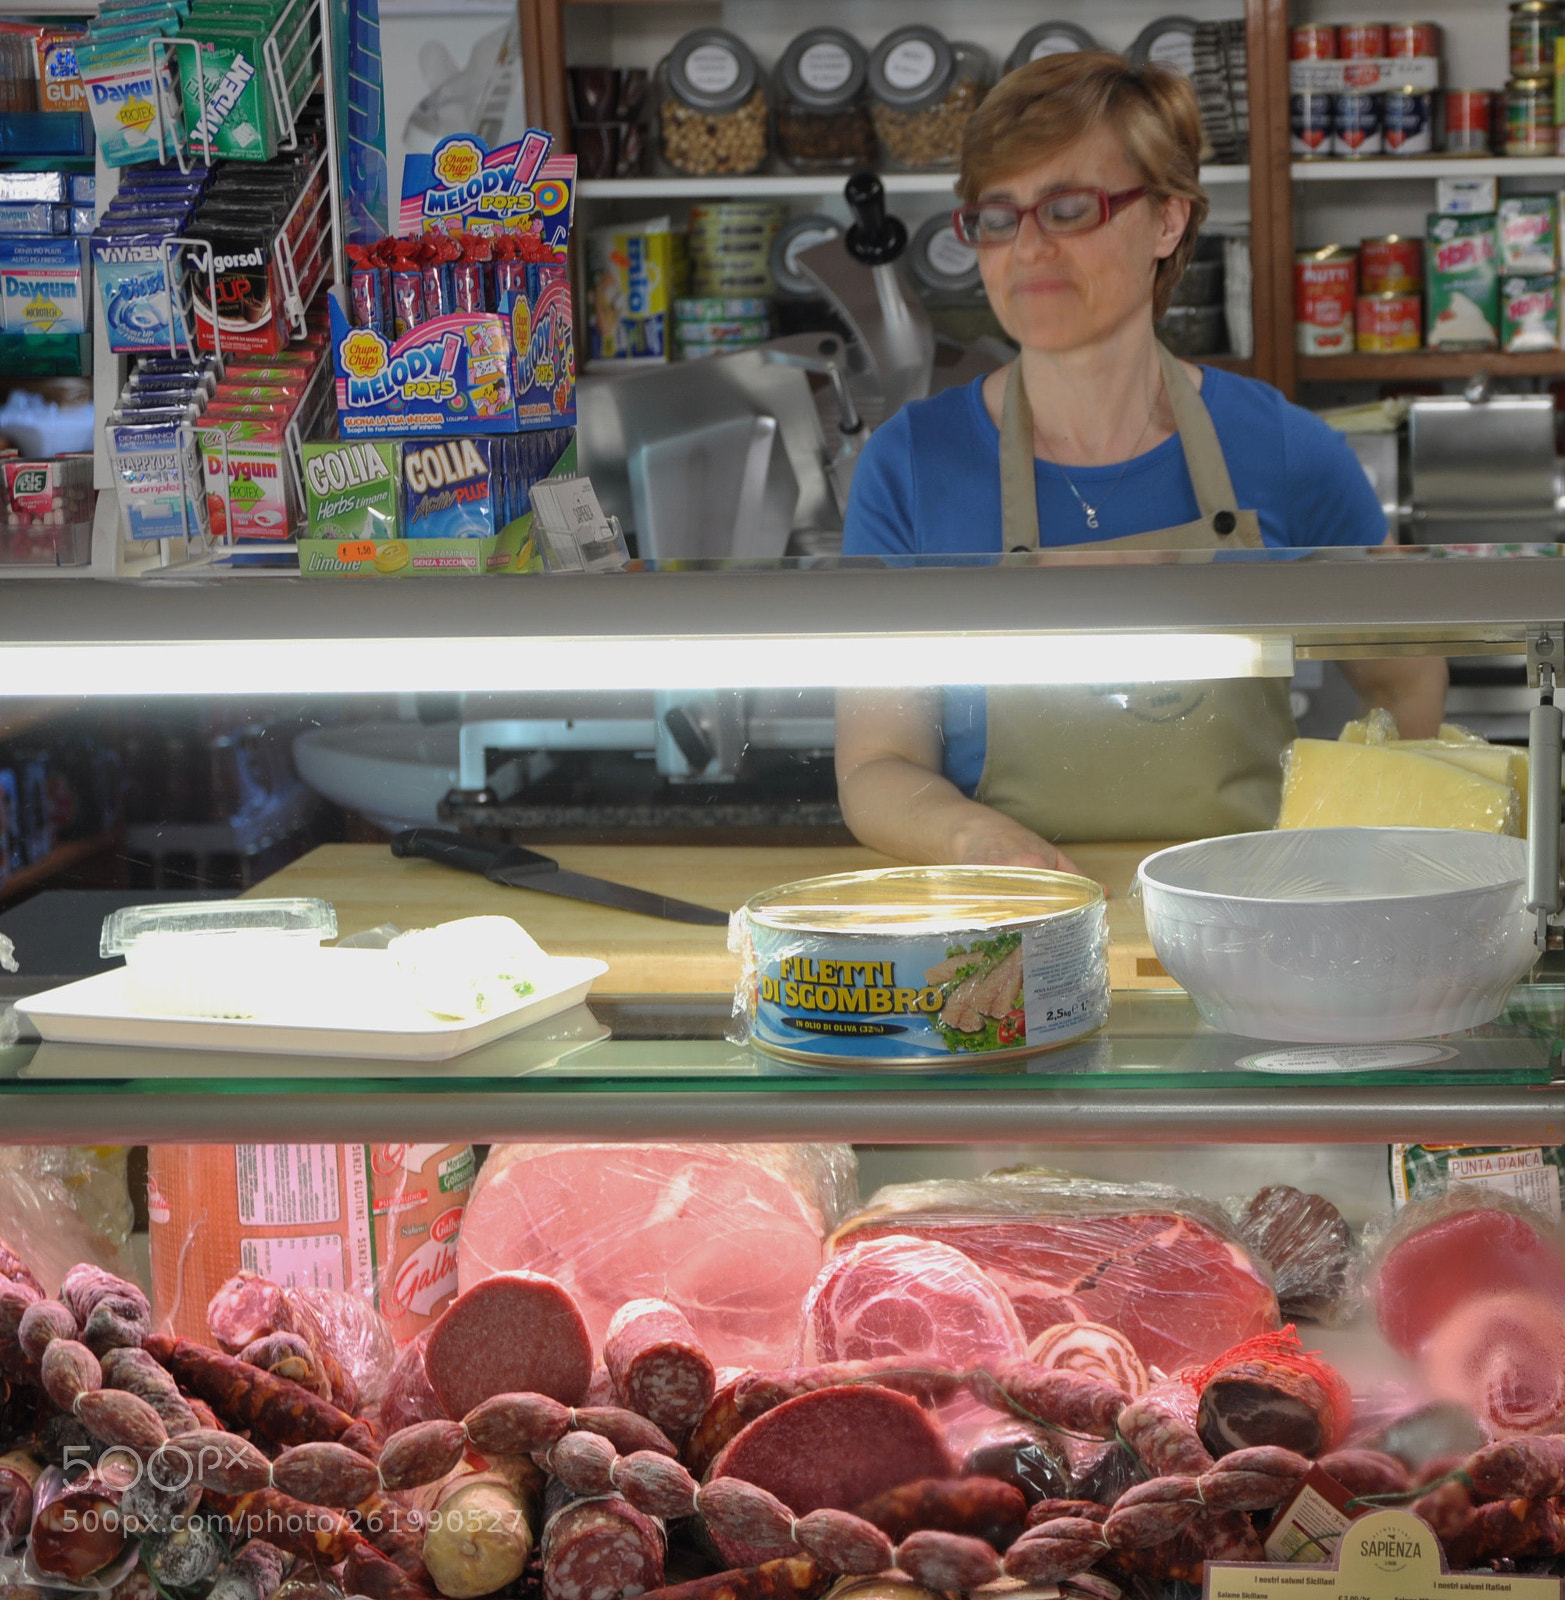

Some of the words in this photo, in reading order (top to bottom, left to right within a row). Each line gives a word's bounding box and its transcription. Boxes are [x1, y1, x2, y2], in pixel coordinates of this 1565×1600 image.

[119, 104, 153, 123] PROTEX
[445, 154, 474, 164] Chupa
[443, 162, 472, 176] Chups
[426, 167, 516, 213] MELODY
[480, 195, 531, 209] POPS
[187, 247, 263, 273] Vgorsol
[6, 276, 77, 303] Daygum
[205, 279, 251, 303] CUP
[349, 344, 379, 357] Chupa
[349, 355, 379, 371] Chups
[351, 346, 445, 404] MELODY
[404, 381, 454, 397] POPS
[344, 415, 375, 427] SUONA
[375, 415, 388, 426] LA
[117, 454, 193, 472] HAPPYDET
[20, 481, 42, 491] tac
[24, 472, 43, 481] tic
[229, 487, 260, 499] PROTEX
[456, 481, 490, 505] PLUS
[317, 495, 356, 521] Herbs
[355, 491, 388, 509] Limone
[308, 552, 362, 572] Limone
[413, 558, 438, 567] SENZA
[780, 955, 896, 987] FILETTI
[761, 974, 781, 1004] DI
[784, 981, 944, 1014] SGOMBRO
[796, 1019, 804, 1028] IN
[804, 1020, 821, 1031] OLIO
[823, 1022, 832, 1031] DI
[833, 1023, 858, 1032] OLIVA
[859, 1025, 885, 1034] (32%)
[352, 1145, 363, 1176] SENZA
[1452, 1158, 1494, 1175] PUNTA
[1497, 1152, 1542, 1172] D'ANCA
[353, 1179, 365, 1222] GLUTINE
[357, 1236, 368, 1272] SENZA
[1360, 1540, 1422, 1559] SAPIENZA
[1258, 1575, 1280, 1584] nostri
[1280, 1576, 1305, 1585] salumi
[1305, 1577, 1336, 1586] Siciliani
[1438, 1582, 1459, 1590] nostri
[1460, 1582, 1484, 1591] salumi
[1485, 1583, 1512, 1592] Italiani
